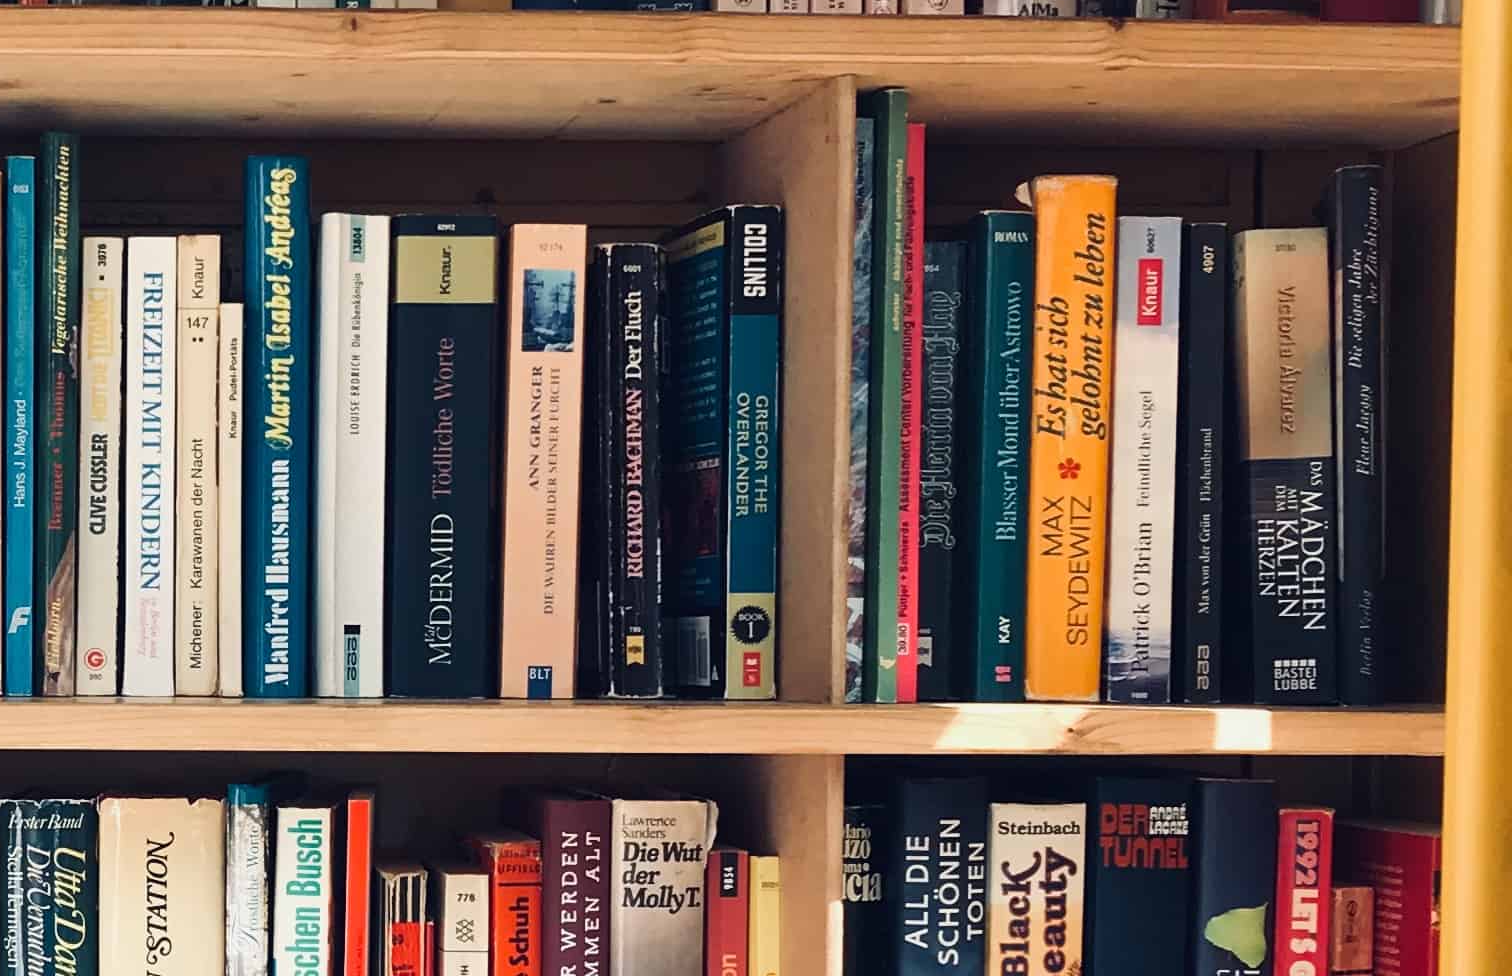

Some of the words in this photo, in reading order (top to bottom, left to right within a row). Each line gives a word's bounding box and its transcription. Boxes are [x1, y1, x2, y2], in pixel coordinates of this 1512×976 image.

[269, 167, 297, 270] Andreas
[191, 256, 205, 300] Knaur
[743, 224, 766, 298] COLLINS
[1074, 214, 1106, 287] leben
[267, 275, 294, 350] Isabel
[624, 291, 643, 341] Fluch
[1079, 294, 1105, 330] zu
[1143, 269, 1159, 316] Knaur
[142, 272, 165, 394] FREIZEIT
[186, 316, 210, 329] 147
[1001, 281, 1024, 363] Astrowo
[1038, 296, 1070, 349] sich
[624, 345, 642, 381] Der
[998, 364, 1022, 409] über
[1038, 353, 1067, 402] hat
[1075, 336, 1105, 439] gelohnt
[140, 400, 163, 454] MIT
[266, 355, 295, 450] Martin
[1036, 406, 1066, 439] Es
[89, 434, 110, 492] CUSSLER
[190, 438, 204, 477] Nacht
[625, 388, 644, 480] BACHMAN
[735, 392, 751, 517] OVERLANDER
[755, 394, 767, 474] GREGOR
[996, 414, 1020, 469] Mond
[89, 495, 109, 535] CLIVE
[190, 481, 203, 505] der
[267, 459, 289, 584] Hausmann
[755, 480, 767, 513] THE
[995, 474, 1018, 542] Blasser
[139, 463, 162, 591] KINDERN
[190, 509, 204, 589] Karawanen
[625, 483, 644, 579] RICHARD
[1042, 497, 1064, 557] MAX
[1067, 496, 1092, 646] SEYDEWITZ
[189, 601, 204, 670] Michener:
[264, 588, 289, 686] Manfred
[998, 615, 1011, 644] KAY
[998, 821, 1080, 835] Steinbach
[1100, 804, 1149, 827] DER
[285, 818, 323, 897] Busch
[584, 832, 601, 882] ALT
[622, 842, 659, 862] Die
[662, 842, 702, 861] Wut
[622, 867, 660, 885] der
[905, 835, 930, 880] DIE
[1100, 837, 1189, 869] TUNNEL
[147, 832, 176, 965] STATION
[561, 832, 578, 951] WERDEN
[622, 887, 686, 915] Molly
[687, 889, 699, 908] T.
[904, 890, 930, 948] ALL
[937, 818, 960, 965] SCHÖNEN
[966, 842, 985, 940] TOTEN
[510, 896, 529, 966] Schuh
